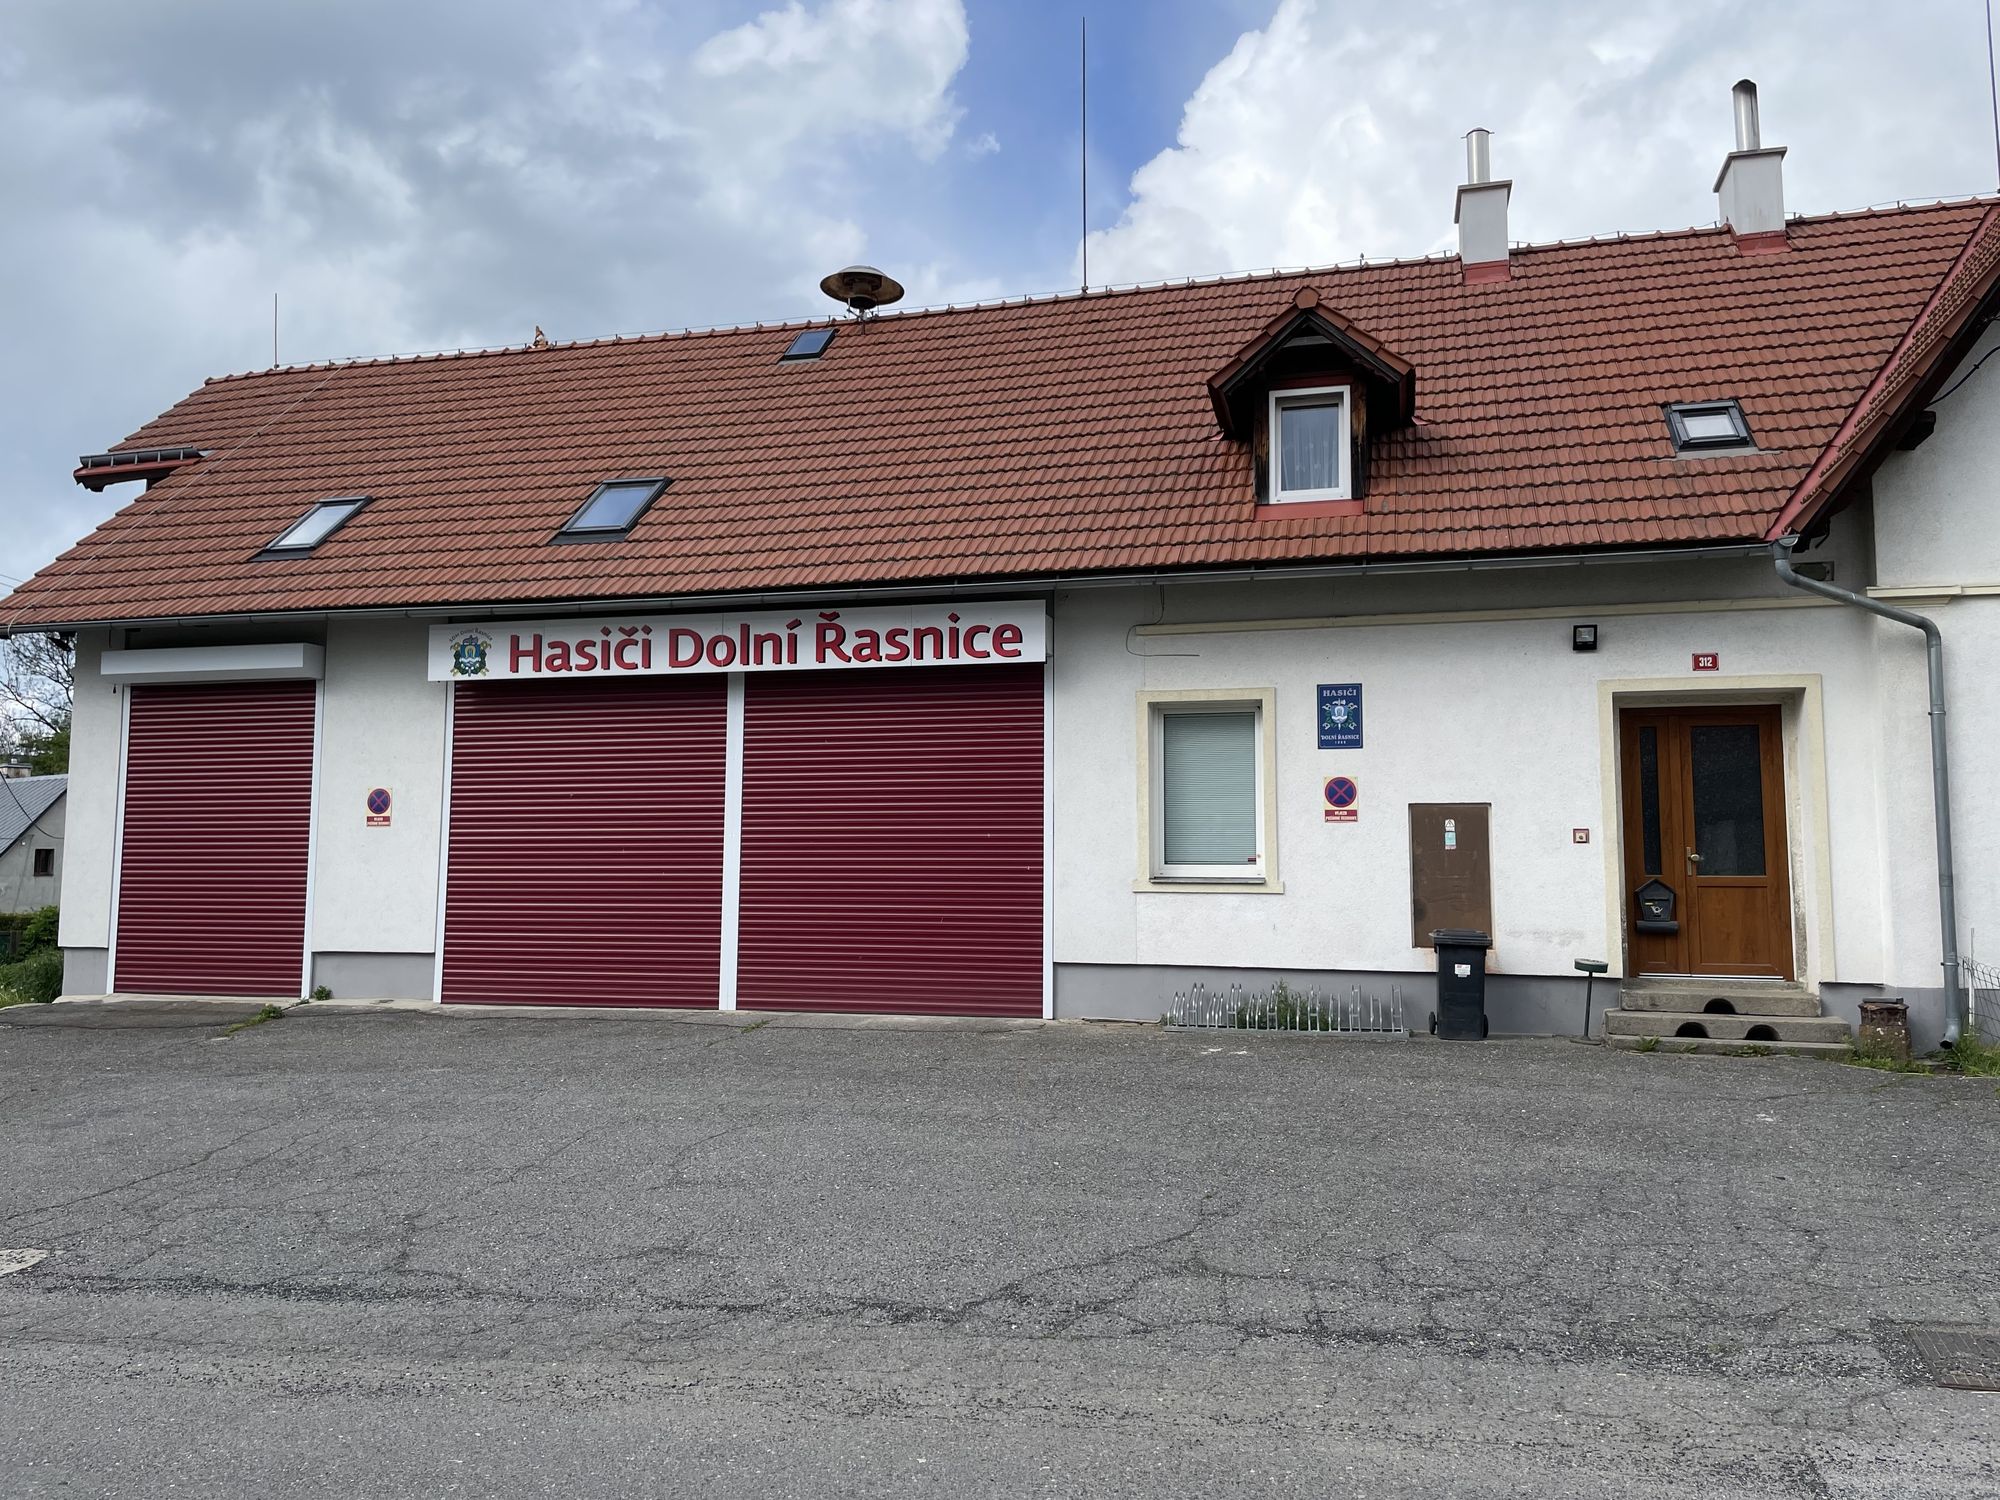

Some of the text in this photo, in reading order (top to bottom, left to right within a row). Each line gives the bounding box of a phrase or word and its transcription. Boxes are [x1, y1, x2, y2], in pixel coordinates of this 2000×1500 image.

[509, 611, 1023, 673] Hasiči Dolní Řasnice
[1699, 656, 1713, 667] 312
[1323, 688, 1357, 697] HASIČI
